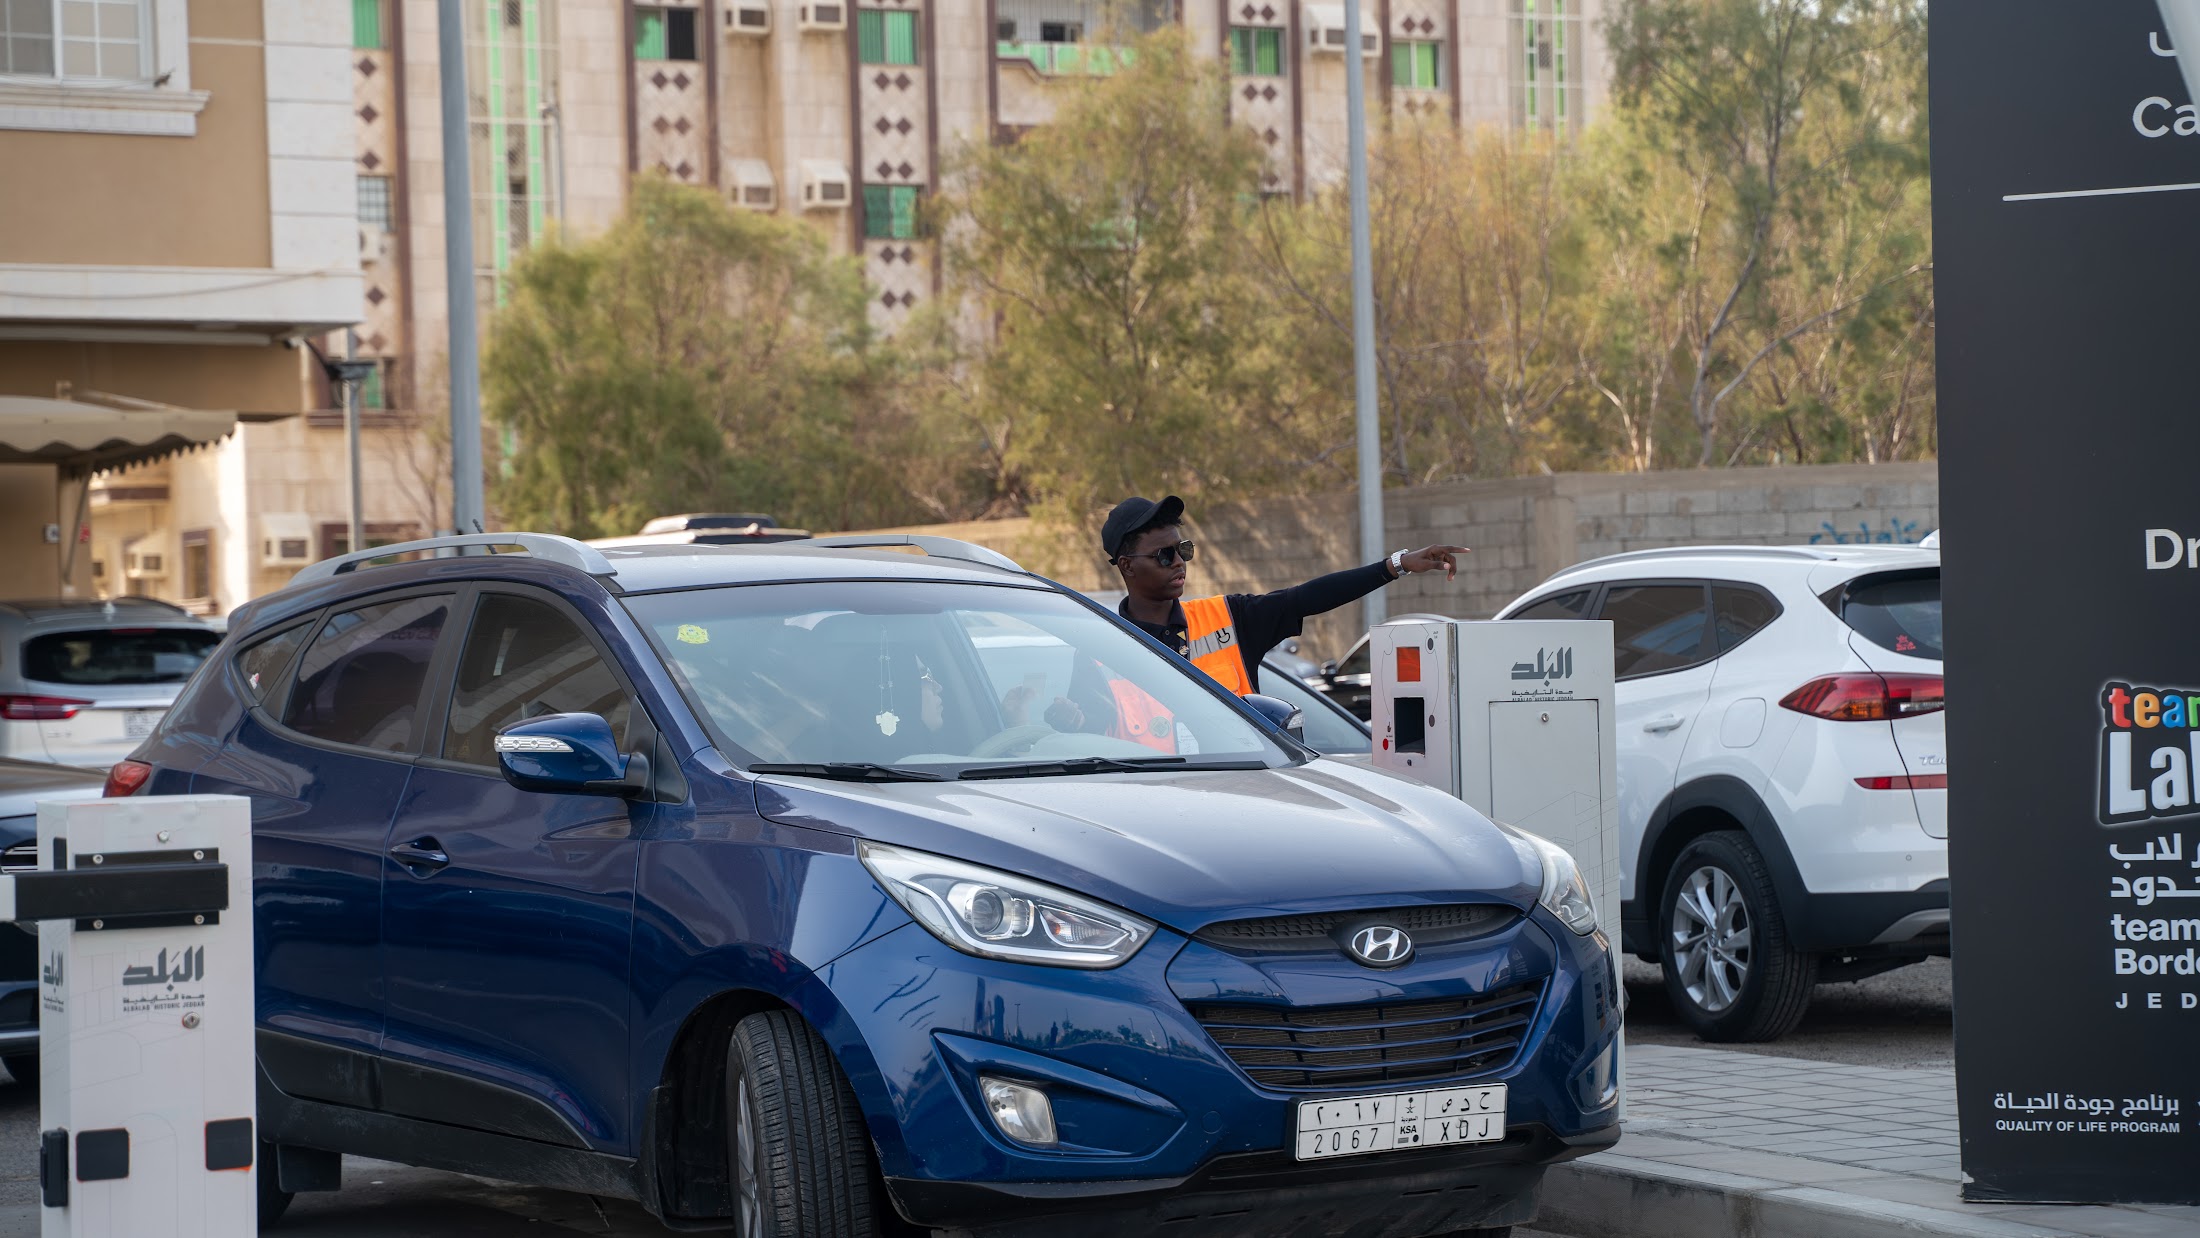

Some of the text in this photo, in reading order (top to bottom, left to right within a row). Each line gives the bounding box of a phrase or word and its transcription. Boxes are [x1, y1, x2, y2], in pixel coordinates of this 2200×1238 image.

[2110, 876, 2200, 906] دود
[2114, 948, 2200, 976] Bord
[154, 1002, 181, 1011] HISTORIC
[1994, 1092, 2180, 1117] برنامج جودة الحياة
[1399, 1124, 1417, 1135] KSA
[1995, 1119, 2180, 1133] QUALITY OF LIFE PROGRAM
